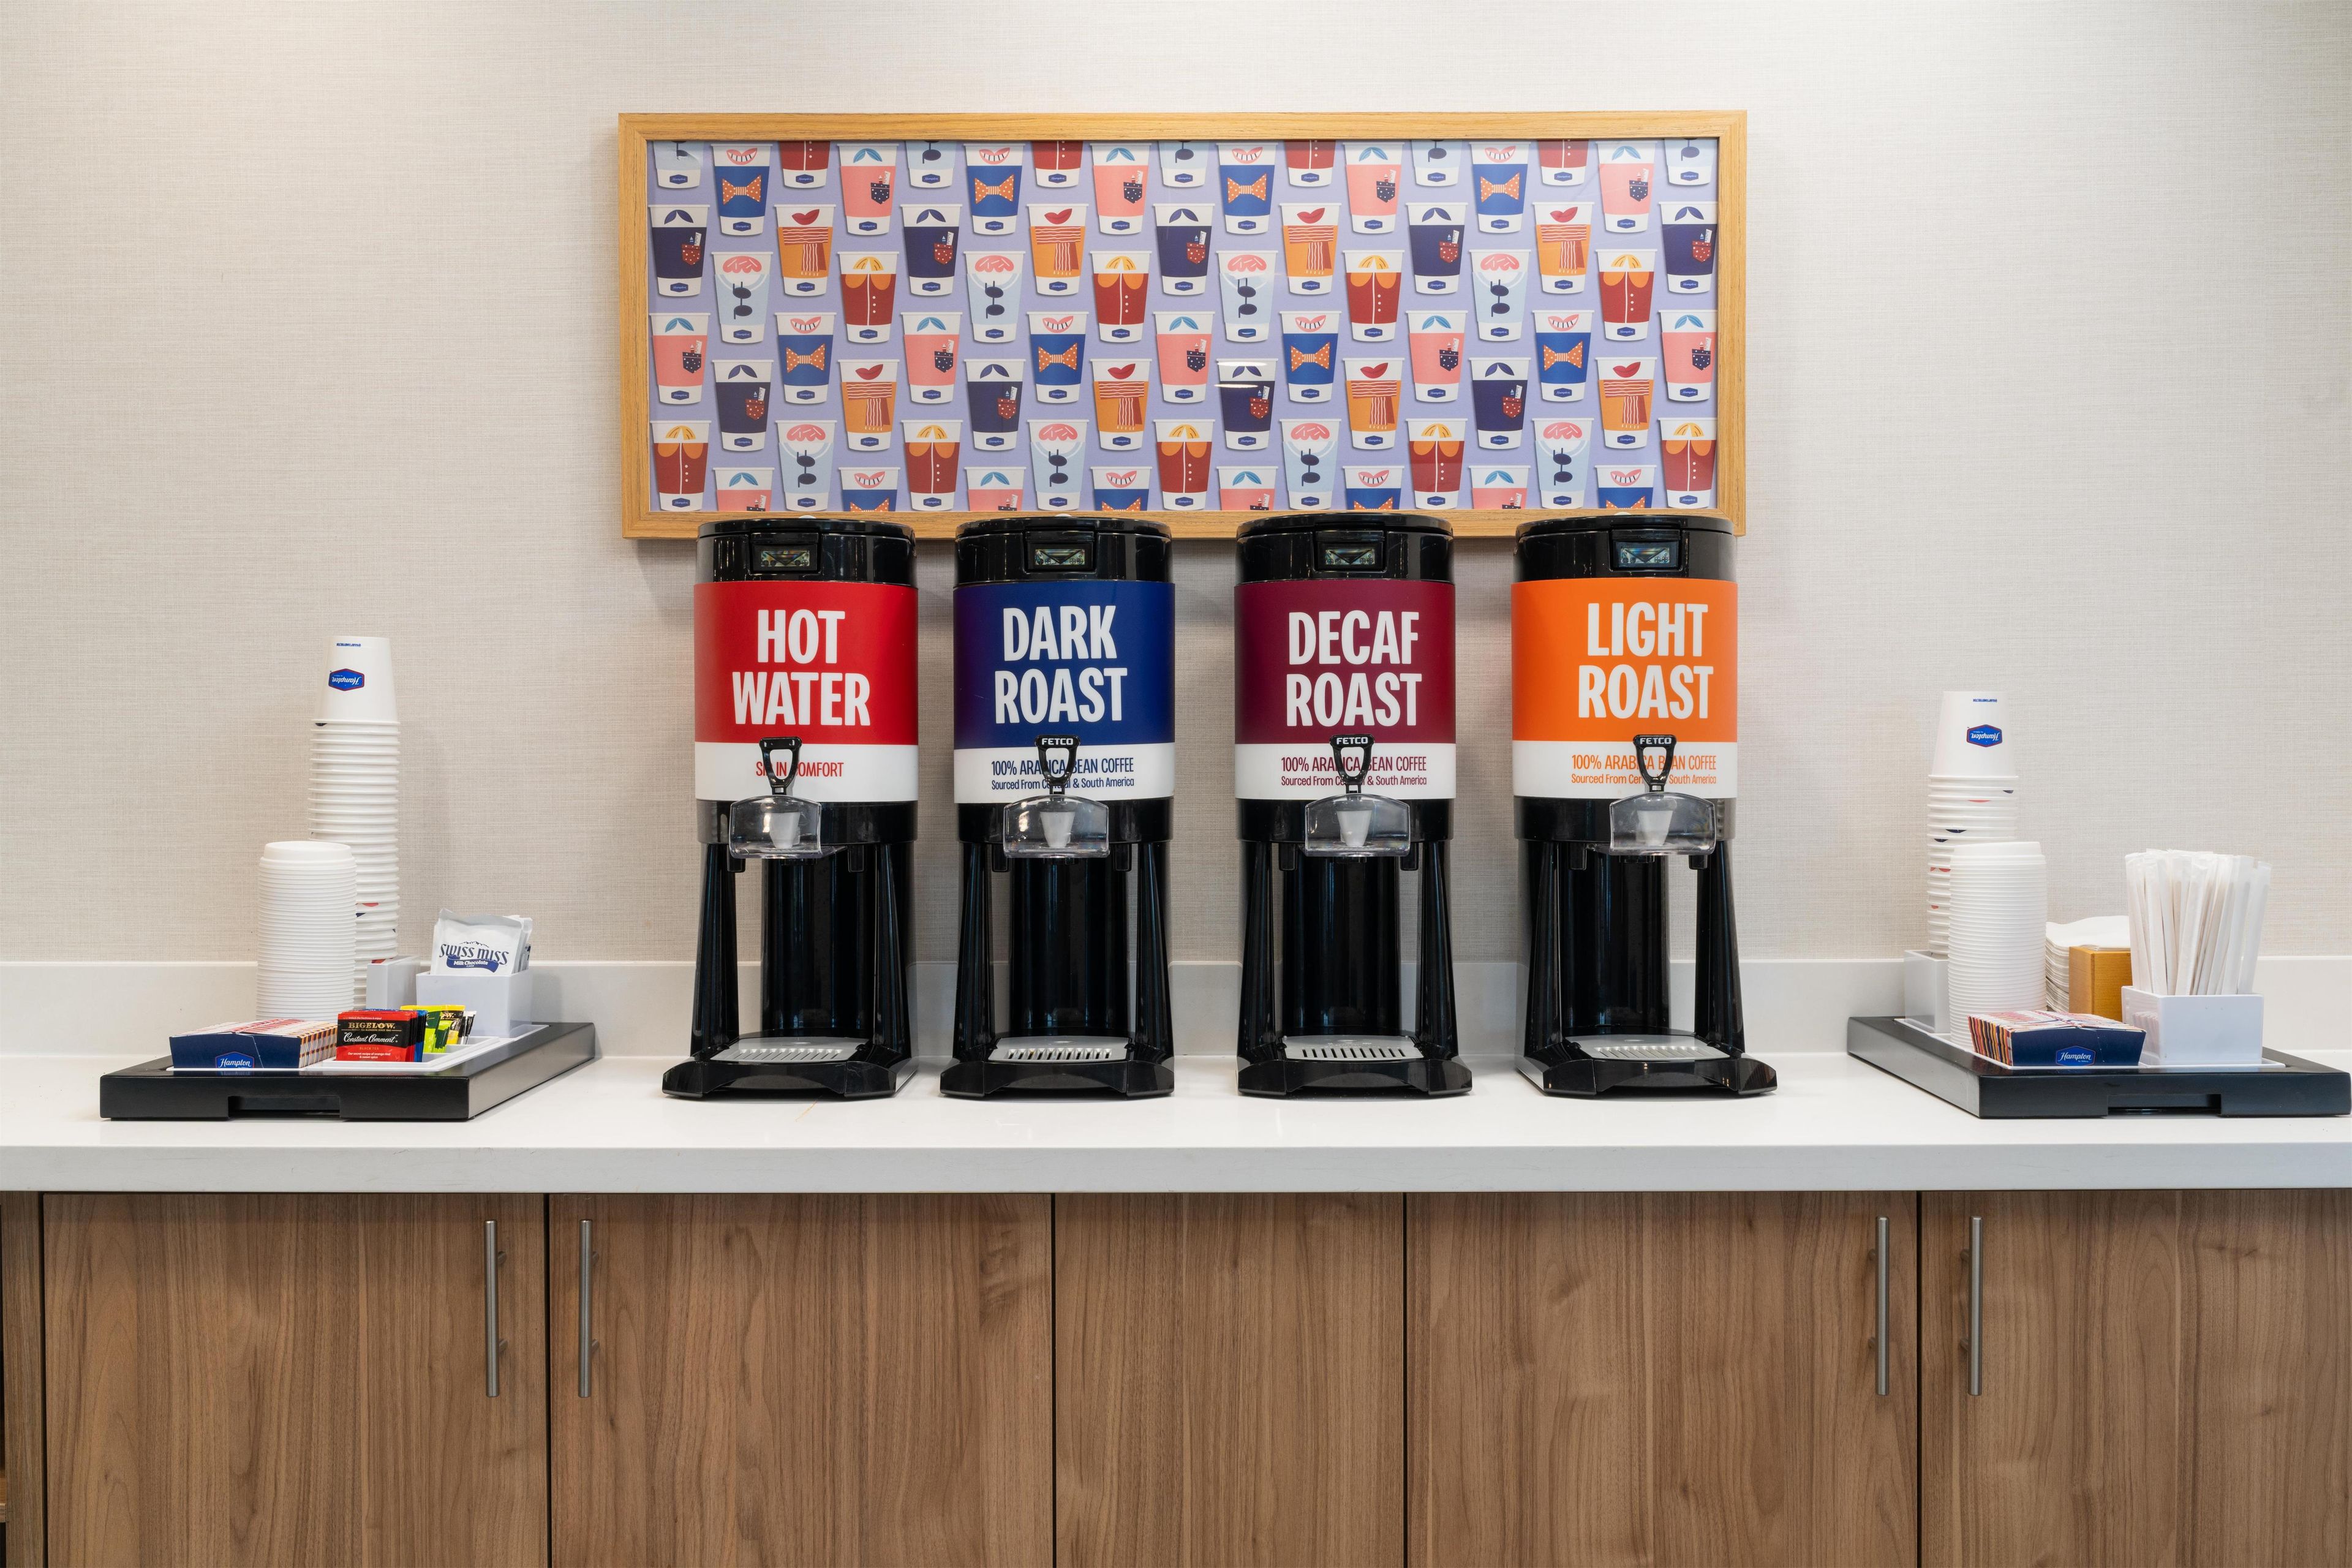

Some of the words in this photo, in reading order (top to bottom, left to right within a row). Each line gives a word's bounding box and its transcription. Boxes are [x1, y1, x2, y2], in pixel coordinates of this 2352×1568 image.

[757, 609, 846, 664] HOT
[1003, 605, 1117, 662] DARK
[1588, 601, 1708, 657] LIGHT
[1288, 610, 1420, 665] DECAF
[332, 676, 361, 685] Hampton
[732, 671, 870, 726] WATER
[995, 667, 1128, 724] ROAST
[1286, 672, 1422, 726] ROAST
[1578, 664, 1714, 719] ROAST
[1970, 733, 2000, 741] Hampton
[776, 761, 787, 776] IN
[797, 762, 844, 777] OMFORT
[992, 760, 1017, 775] 100%
[1020, 759, 1066, 775] ARAICA
[1102, 758, 1134, 772] COFFEE
[1281, 757, 1309, 771] 100%
[1312, 756, 1361, 771] ARAICA
[1396, 756, 1427, 771] COFFEE
[1572, 755, 1601, 769] 100%
[1659, 755, 1685, 769] BAN
[1689, 755, 1716, 770] COFFEE
[992, 780, 1019, 790] Sourced
[1021, 780, 1040, 789] From
[1073, 778, 1080, 788] &
[1082, 778, 1104, 788] South
[1106, 777, 1134, 786] America
[1281, 775, 1311, 785] Sourced
[1313, 776, 1333, 785] From
[1367, 775, 1374, 785] &
[1376, 775, 1398, 785] South
[1400, 775, 1427, 785] America
[1572, 773, 1604, 783] Sourced
[1606, 774, 1627, 783] From
[1669, 774, 1690, 784] South
[1692, 774, 1716, 784] America
[439, 944, 475, 958] SWISS
[219, 1058, 251, 1068] Hampton
[2058, 1052, 2092, 1061] Hampton
